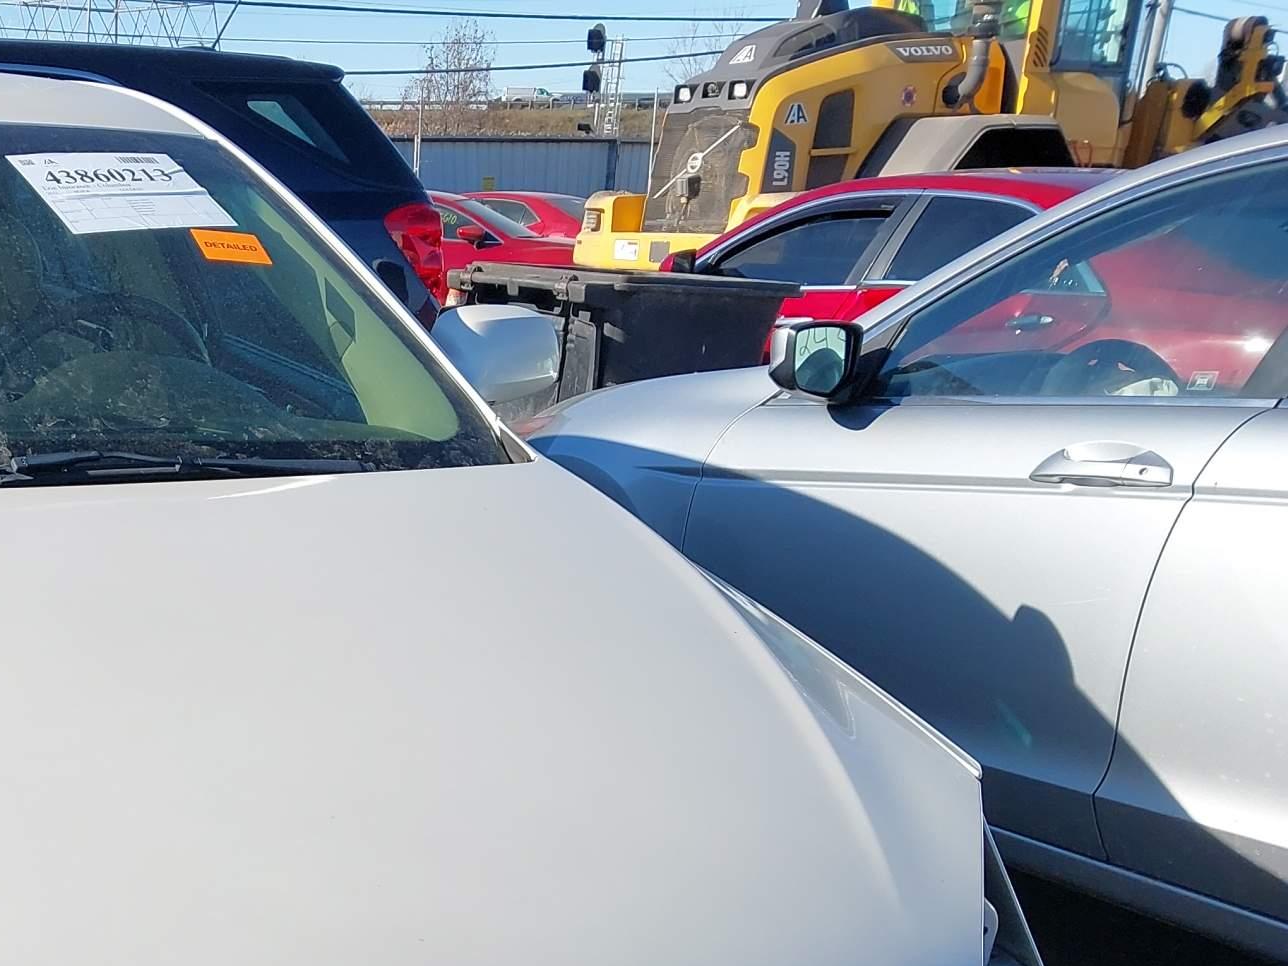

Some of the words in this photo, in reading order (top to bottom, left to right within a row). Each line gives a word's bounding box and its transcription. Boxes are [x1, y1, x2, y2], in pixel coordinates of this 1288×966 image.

[896, 45, 953, 57] VOLVO
[45, 167, 172, 185] 43860213
[772, 151, 791, 186] L90H
[203, 241, 258, 253] DETAILED
